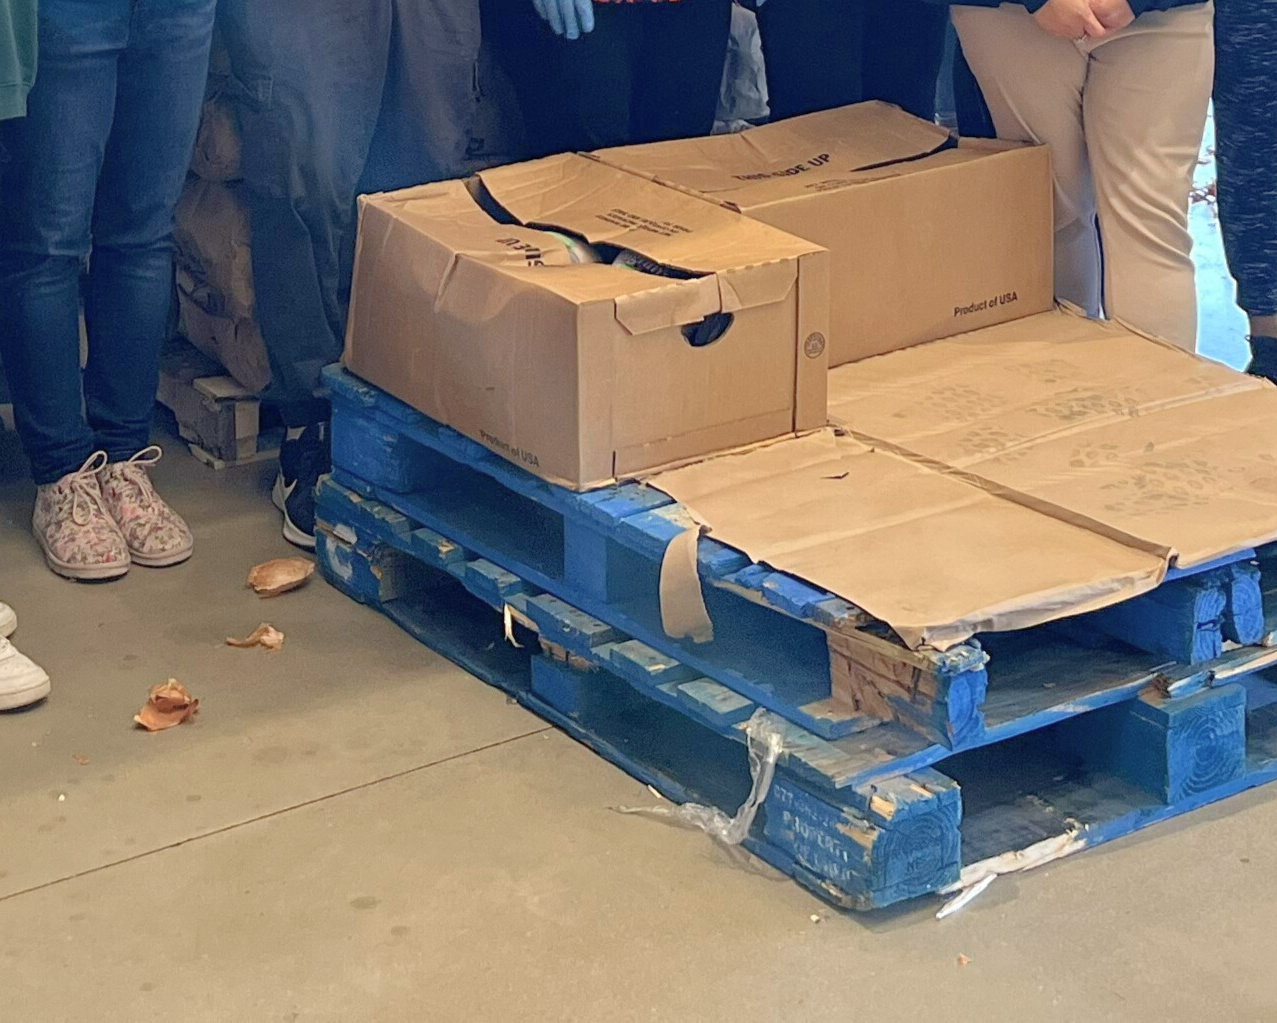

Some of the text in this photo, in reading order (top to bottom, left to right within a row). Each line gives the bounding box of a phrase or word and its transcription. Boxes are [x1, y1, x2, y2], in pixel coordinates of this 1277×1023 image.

[807, 153, 831, 167] UP
[953, 291, 1018, 318] Product of USA
[521, 448, 540, 467] USA
